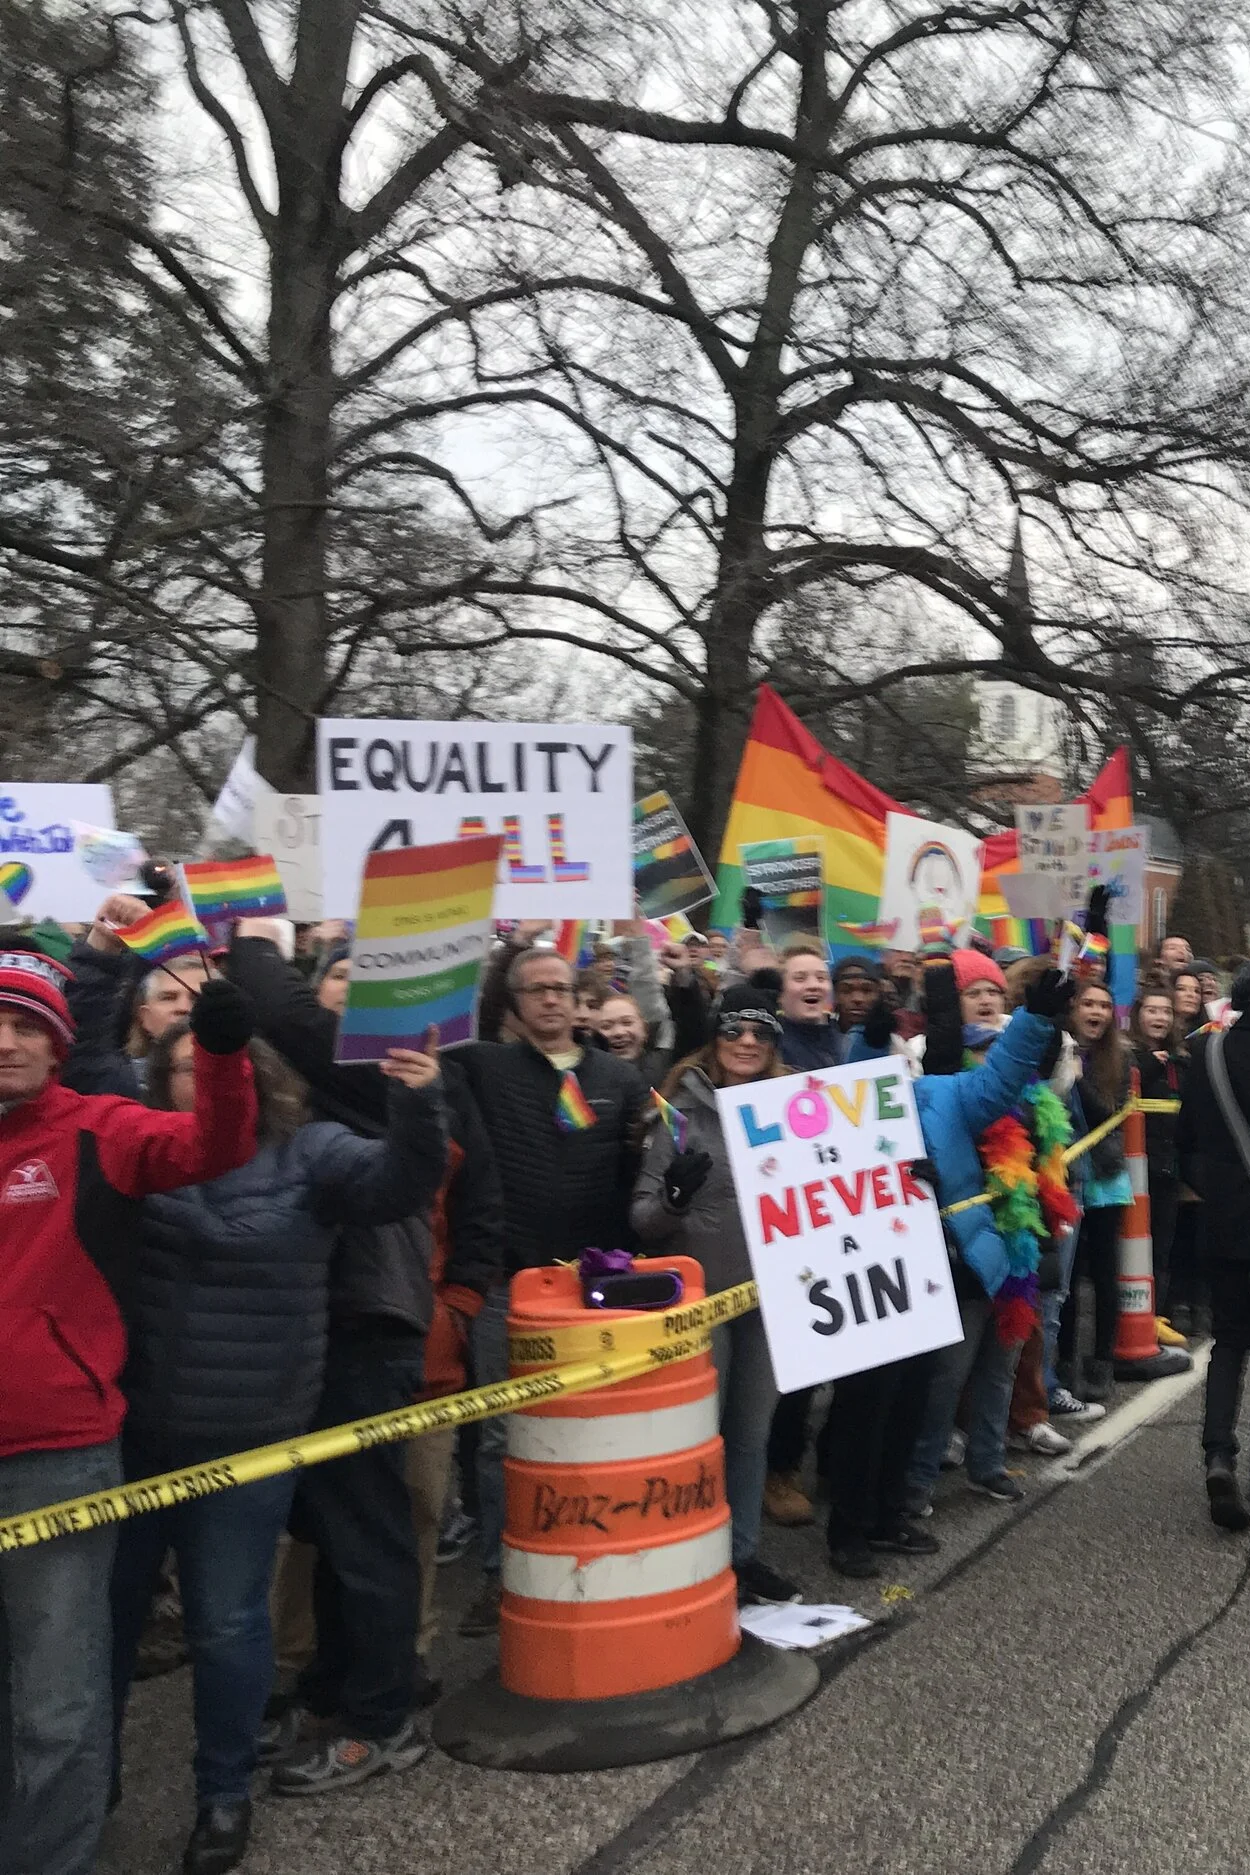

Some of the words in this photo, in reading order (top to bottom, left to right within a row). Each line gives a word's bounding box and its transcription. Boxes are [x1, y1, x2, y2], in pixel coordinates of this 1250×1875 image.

[328, 737, 616, 794] EQUALITY
[737, 1074, 905, 1148] LOVE
[757, 1160, 929, 1245] NEVER
[840, 1234, 861, 1255] A
[808, 1256, 912, 1337] SIN
[32, 1508, 80, 1541] LINE
[86, 1497, 119, 1526] DO
[120, 1484, 161, 1516] NOT
[170, 1463, 237, 1501] CROSS
